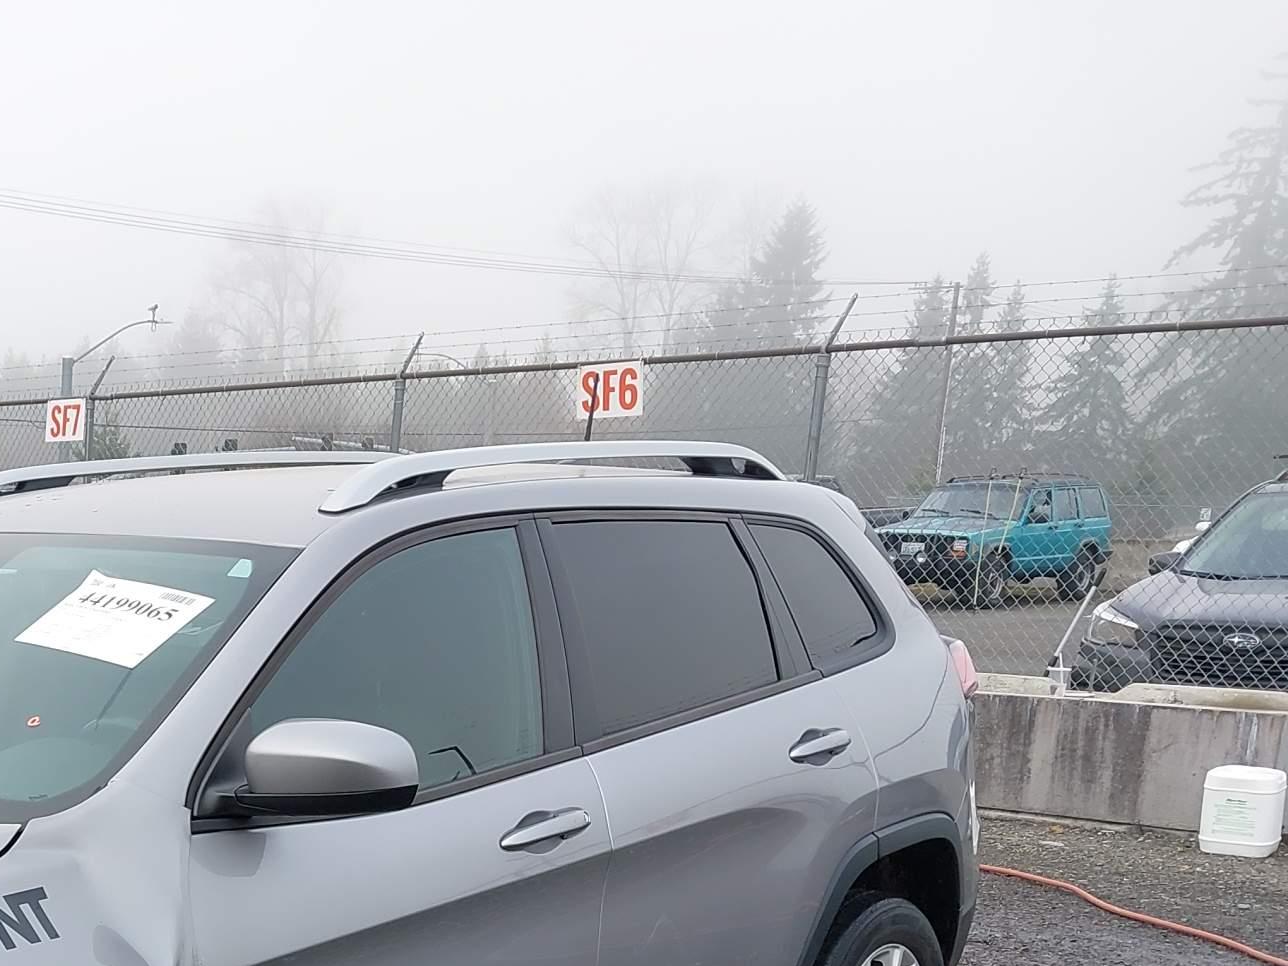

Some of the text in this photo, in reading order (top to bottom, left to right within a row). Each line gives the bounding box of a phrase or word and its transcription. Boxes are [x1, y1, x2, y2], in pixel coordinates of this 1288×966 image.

[582, 367, 638, 413] SF6
[50, 404, 81, 438] SF7
[78, 591, 180, 622] 44199065
